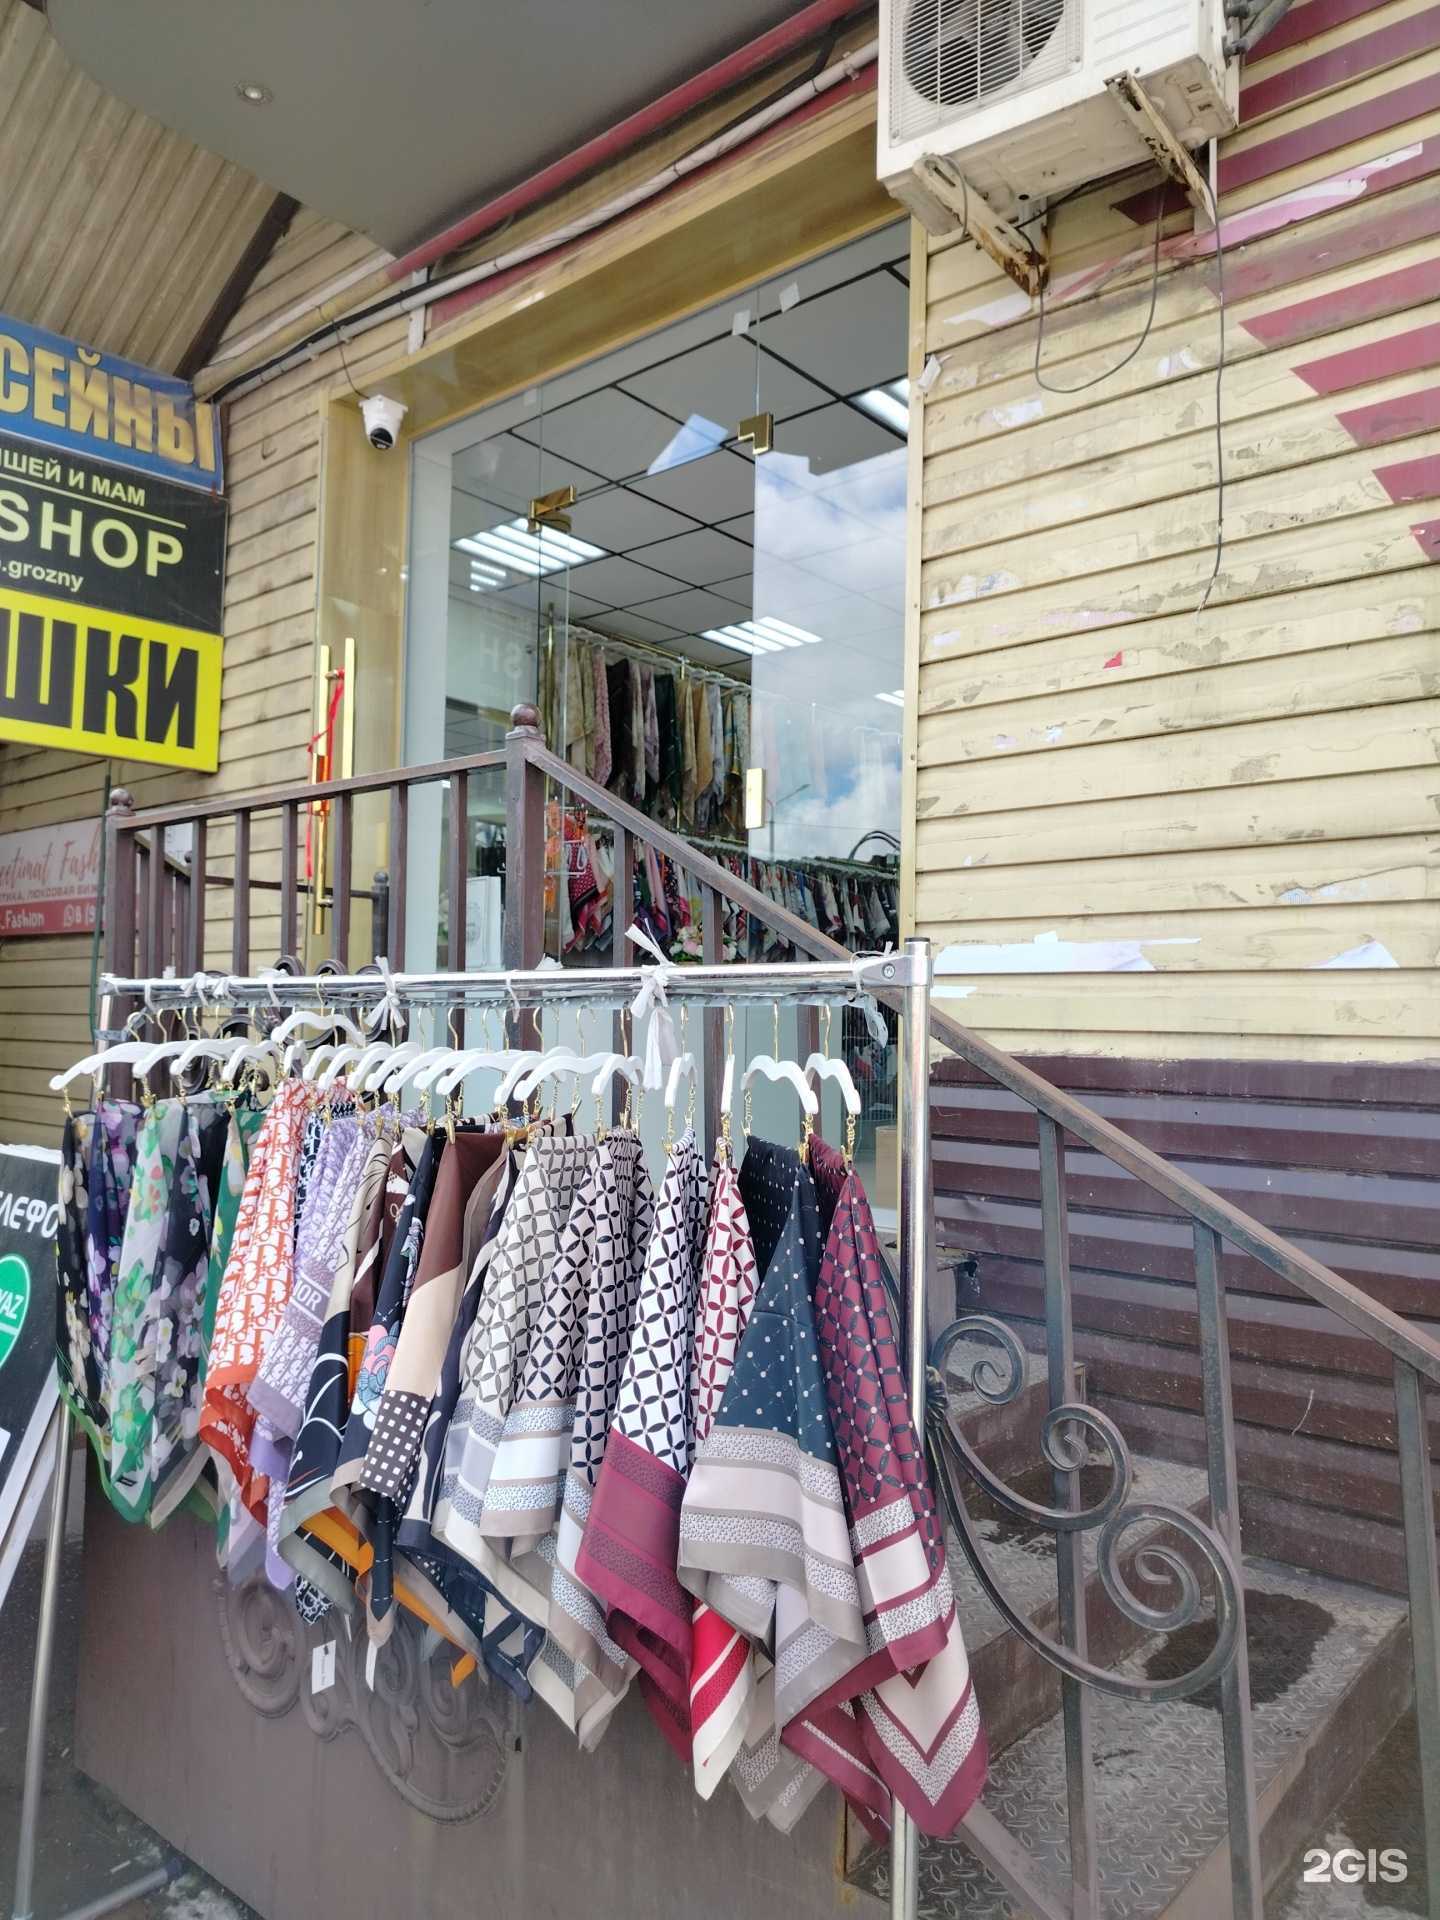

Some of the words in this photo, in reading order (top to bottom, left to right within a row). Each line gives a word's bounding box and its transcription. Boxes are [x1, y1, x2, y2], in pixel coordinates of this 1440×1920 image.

[0, 448, 61, 483] ШЕЙ
[68, 469, 85, 490] И
[92, 475, 146, 507] МАМ
[0, 490, 183, 577] SHOP
[0, 560, 84, 592] .grozny
[0, 1191, 59, 1238] ЛЕФО
